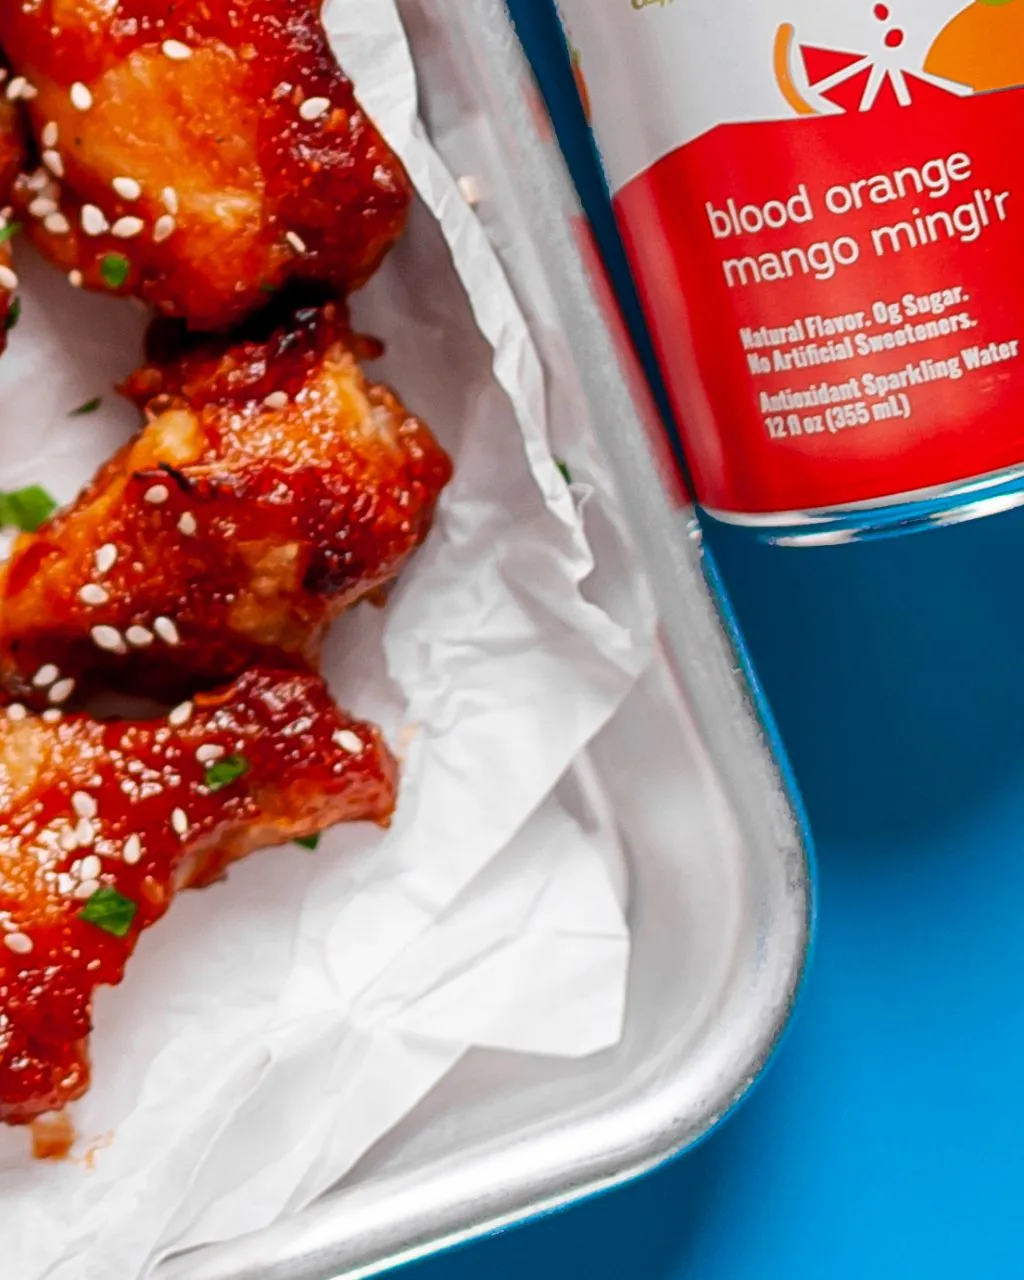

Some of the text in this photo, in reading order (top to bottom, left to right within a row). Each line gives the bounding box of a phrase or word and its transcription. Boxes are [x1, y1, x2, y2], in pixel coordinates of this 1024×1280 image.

[705, 152, 972, 239] blood orange
[722, 188, 1010, 287] mango mingl'r
[739, 319, 804, 350] Natural
[805, 311, 872, 339] Flavor.
[902, 286, 970, 316] Sugar.
[747, 312, 978, 375] No Artificial Sweeteners.
[760, 340, 1019, 413] Antioxidant Sparkling Water
[764, 417, 787, 439] 12
[803, 413, 825, 432] oz
[825, 403, 869, 434] (355
[872, 393, 911, 422] mL)
